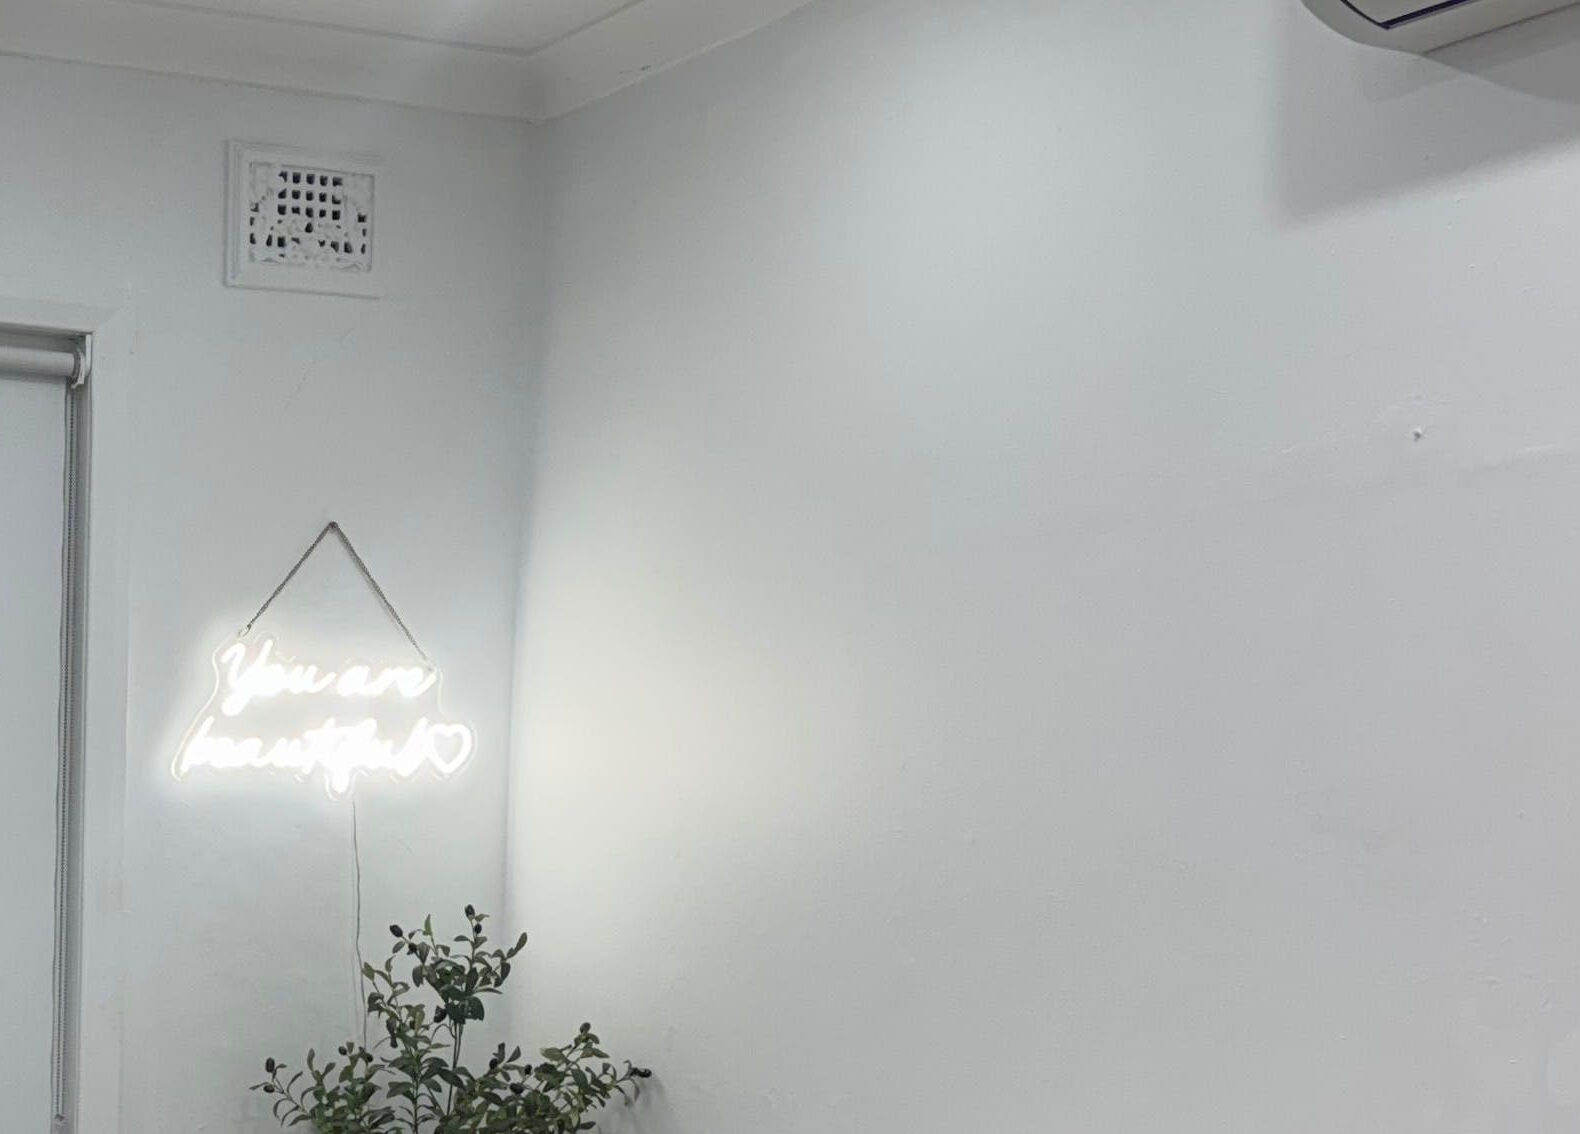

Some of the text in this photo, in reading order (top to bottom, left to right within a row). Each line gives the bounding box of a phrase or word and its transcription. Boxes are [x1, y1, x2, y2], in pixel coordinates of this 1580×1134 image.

[219, 638, 437, 717] You are
[179, 714, 429, 793] beautiful
